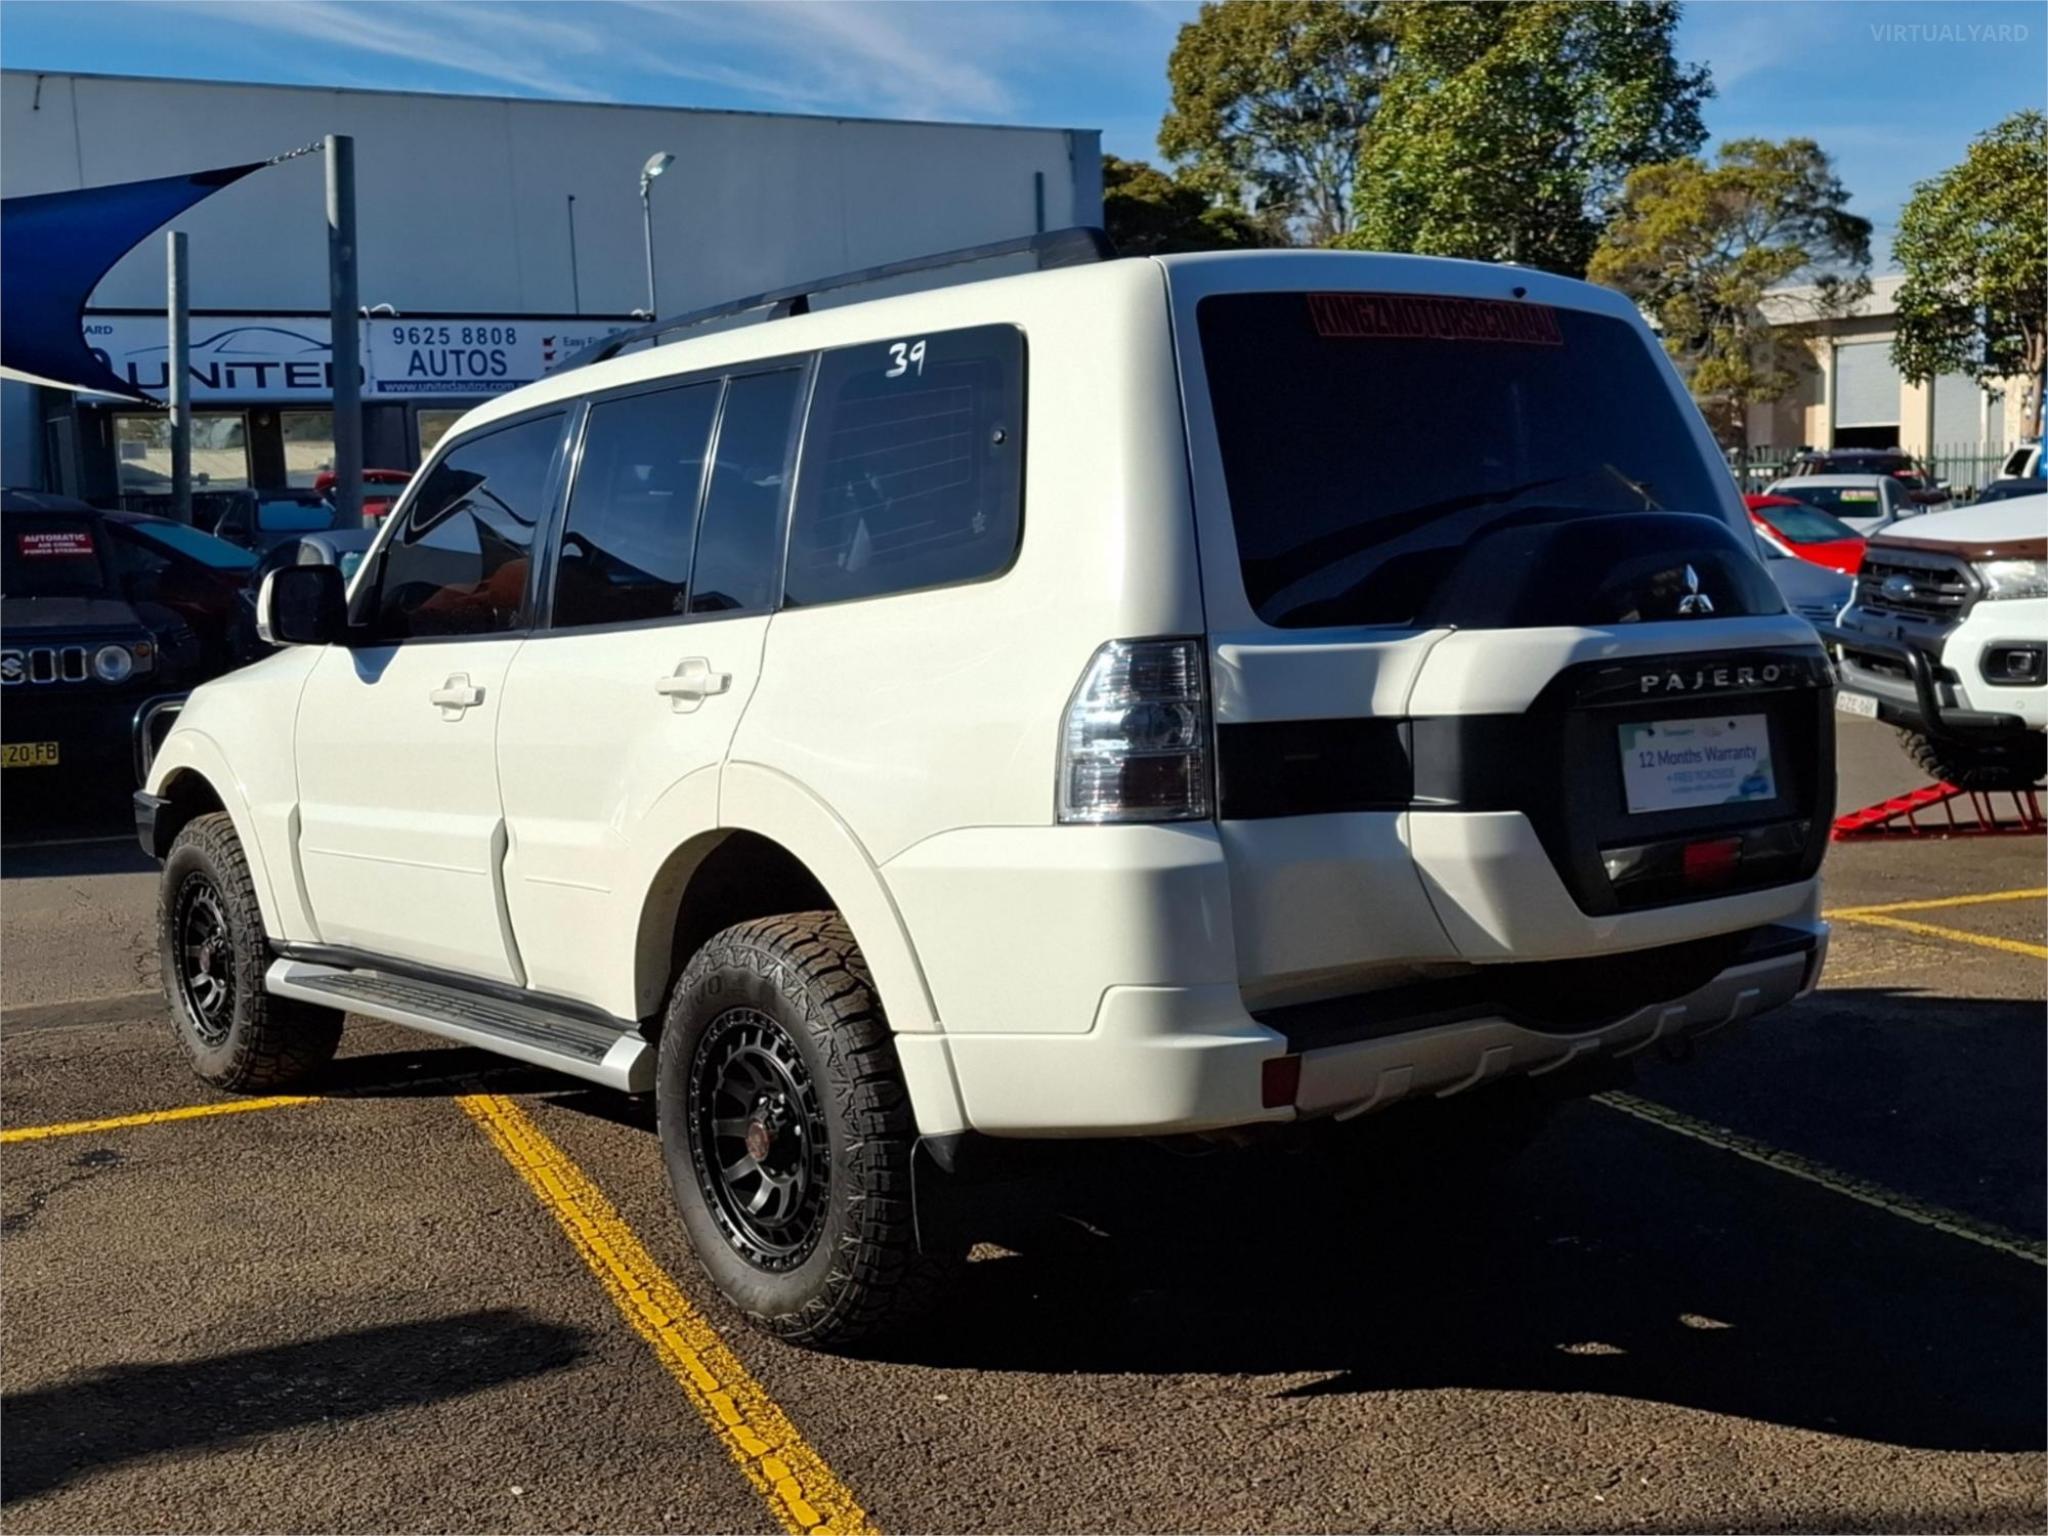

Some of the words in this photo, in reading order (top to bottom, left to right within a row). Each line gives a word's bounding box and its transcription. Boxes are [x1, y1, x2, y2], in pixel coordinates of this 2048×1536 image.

[393, 326, 450, 346] 9625
[461, 326, 517, 346] 8808
[407, 349, 508, 377] AUTOS
[885, 339, 926, 378] 39
[24, 533, 86, 542] AUTOMATIC
[1640, 664, 1780, 693] PAJERO
[8, 744, 30, 763] 20
[35, 743, 57, 761] FB
[1639, 750, 1656, 769] 12
[1657, 747, 1703, 767] Months
[1704, 744, 1757, 765] Warranty
